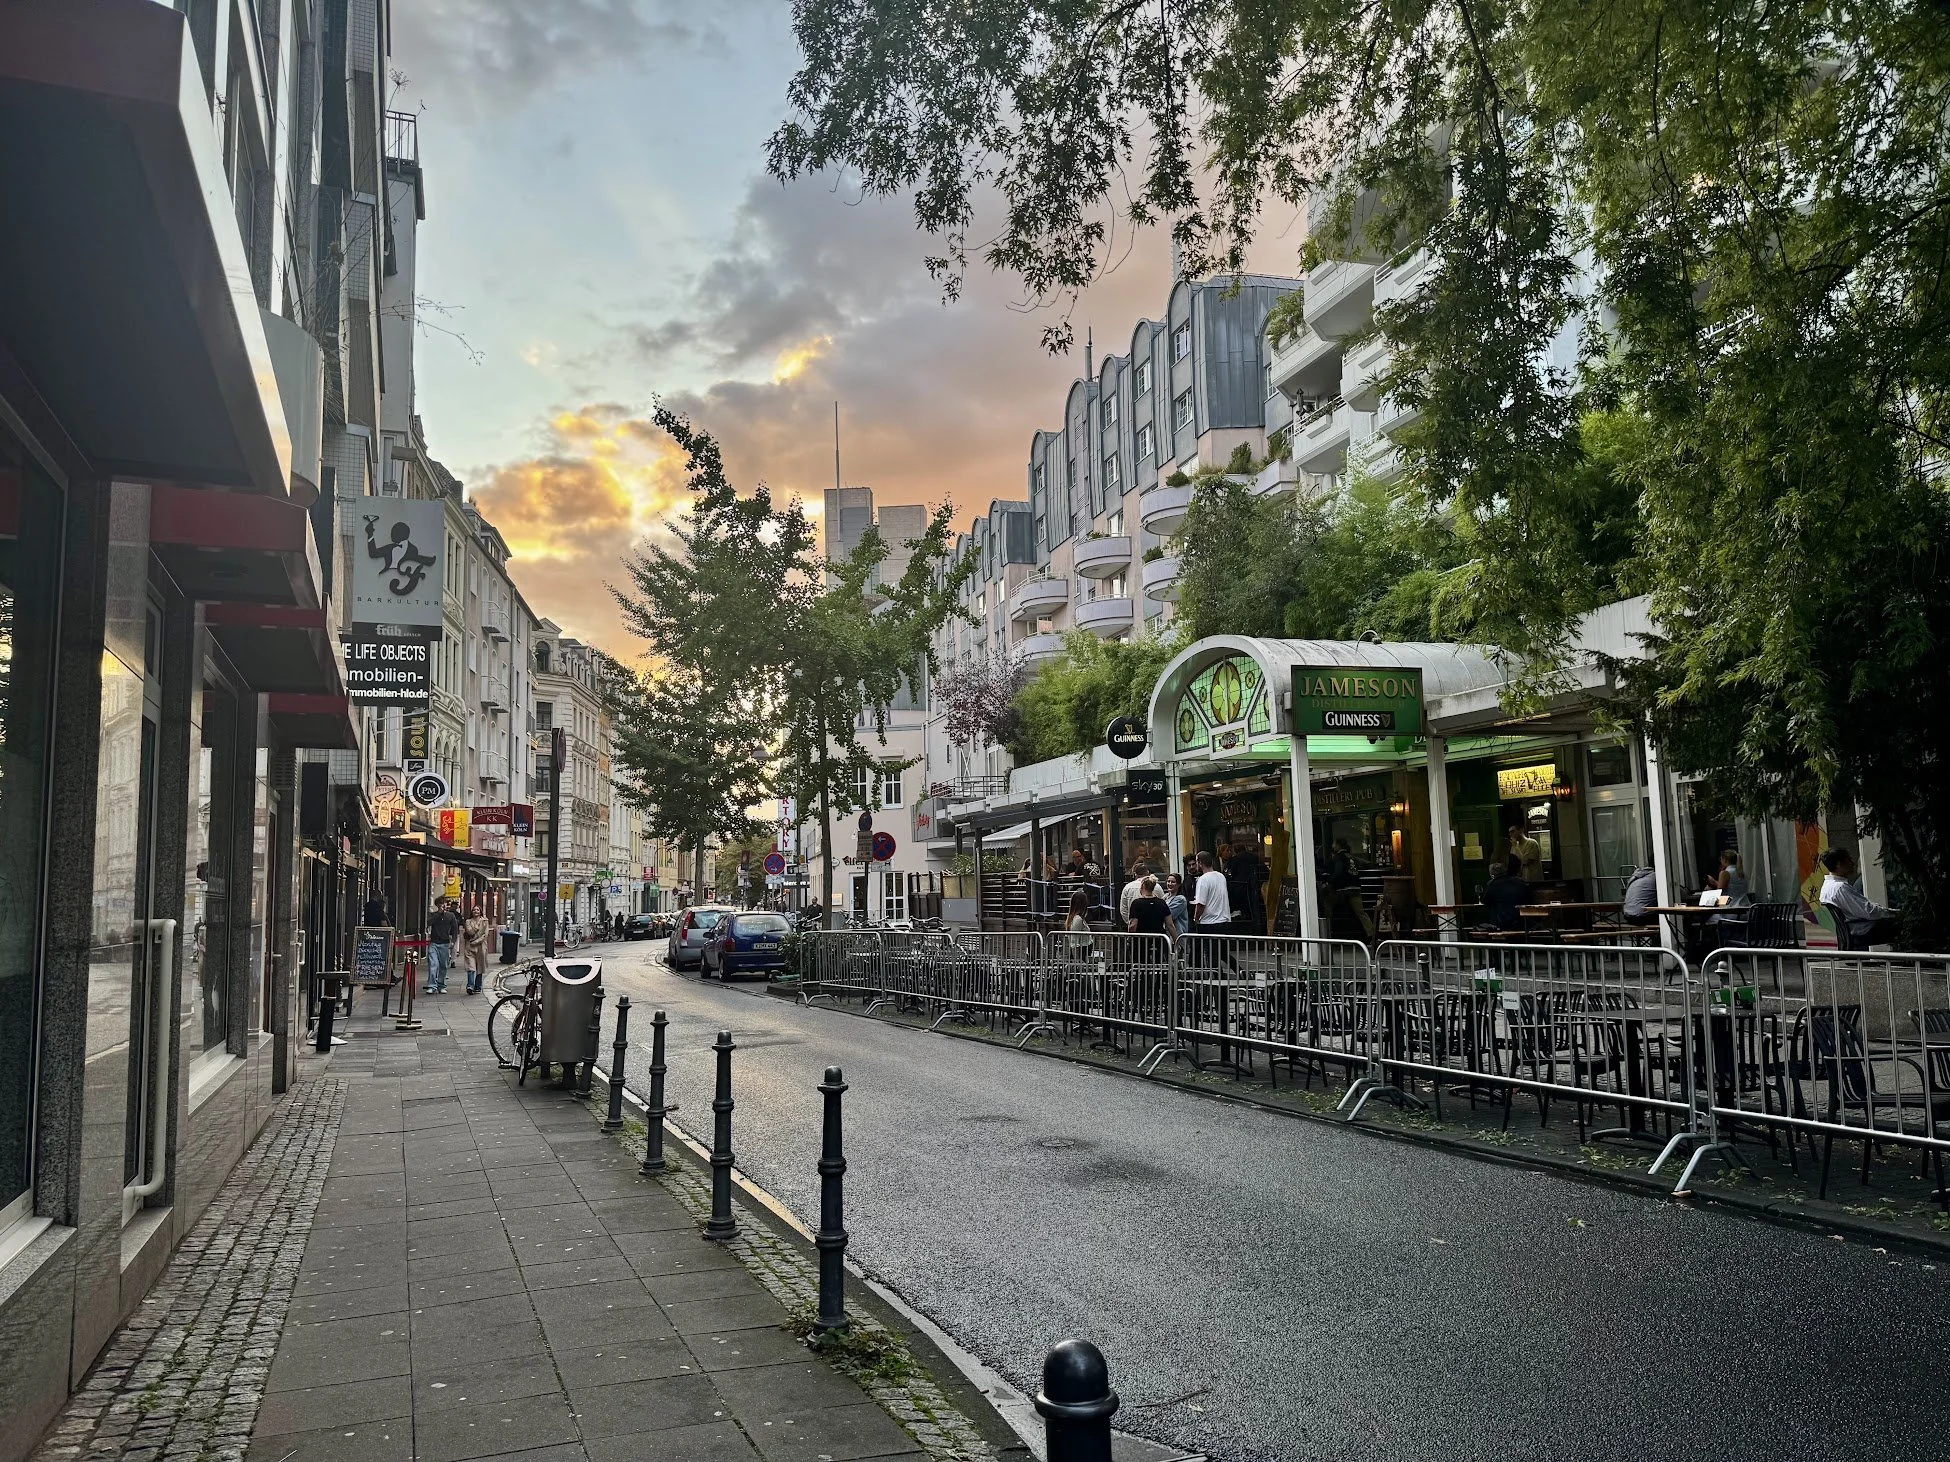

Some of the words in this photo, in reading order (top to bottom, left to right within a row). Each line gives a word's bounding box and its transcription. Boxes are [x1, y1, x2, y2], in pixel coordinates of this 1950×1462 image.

[357, 596, 440, 606] BARKULTUR
[376, 624, 402, 636] früh
[355, 643, 377, 660] LIFE
[380, 644, 426, 661] OBJECTS
[1301, 676, 1417, 698] JAMESON
[1325, 711, 1381, 727] GUINNESS
[1113, 733, 1145, 743] GUINNESS
[421, 786, 437, 795] PM
[1131, 778, 1153, 794] sky
[1153, 782, 1163, 791] 3D
[1356, 789, 1374, 801] PUB
